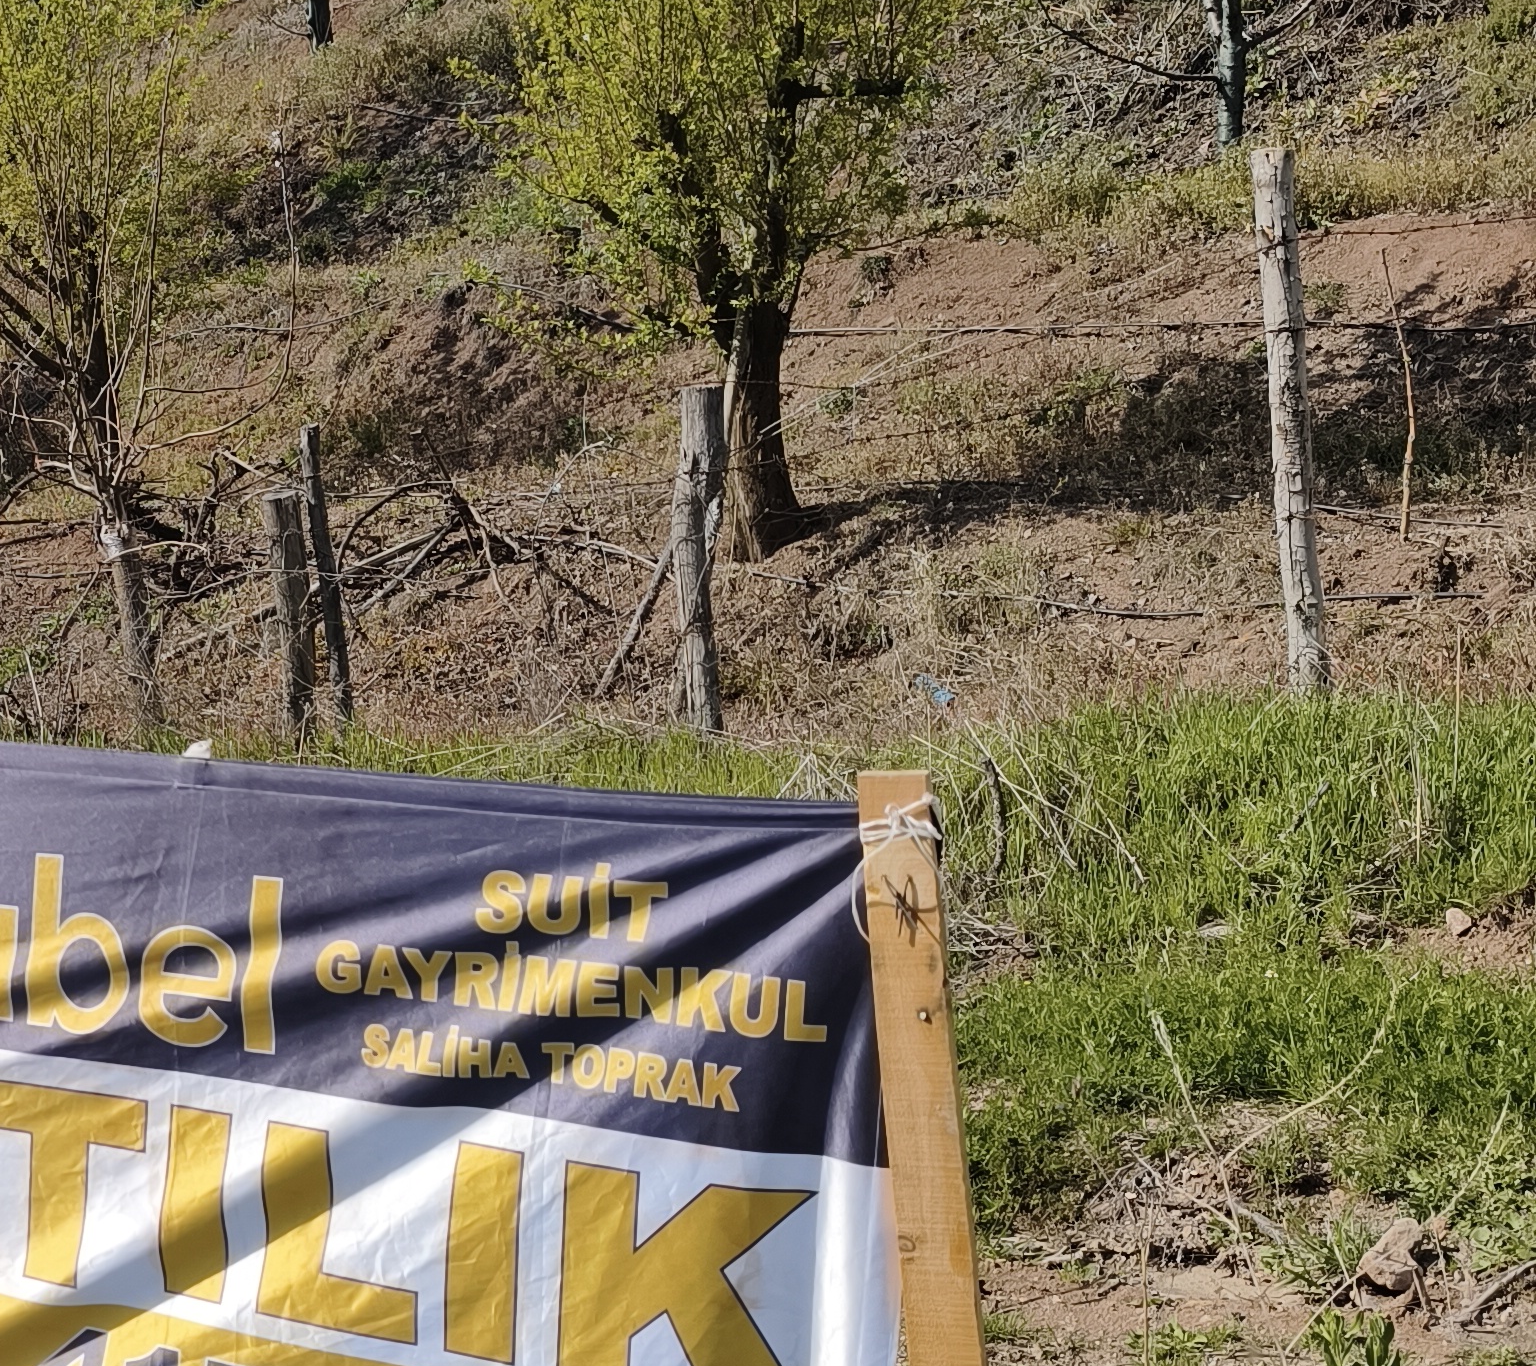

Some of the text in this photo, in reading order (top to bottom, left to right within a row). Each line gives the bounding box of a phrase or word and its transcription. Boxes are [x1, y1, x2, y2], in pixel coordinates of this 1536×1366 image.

[474, 862, 669, 944] SUİT
[315, 940, 828, 1043] GAYRİMENKUL
[361, 1023, 743, 1113] SALİHA TOPRAK
